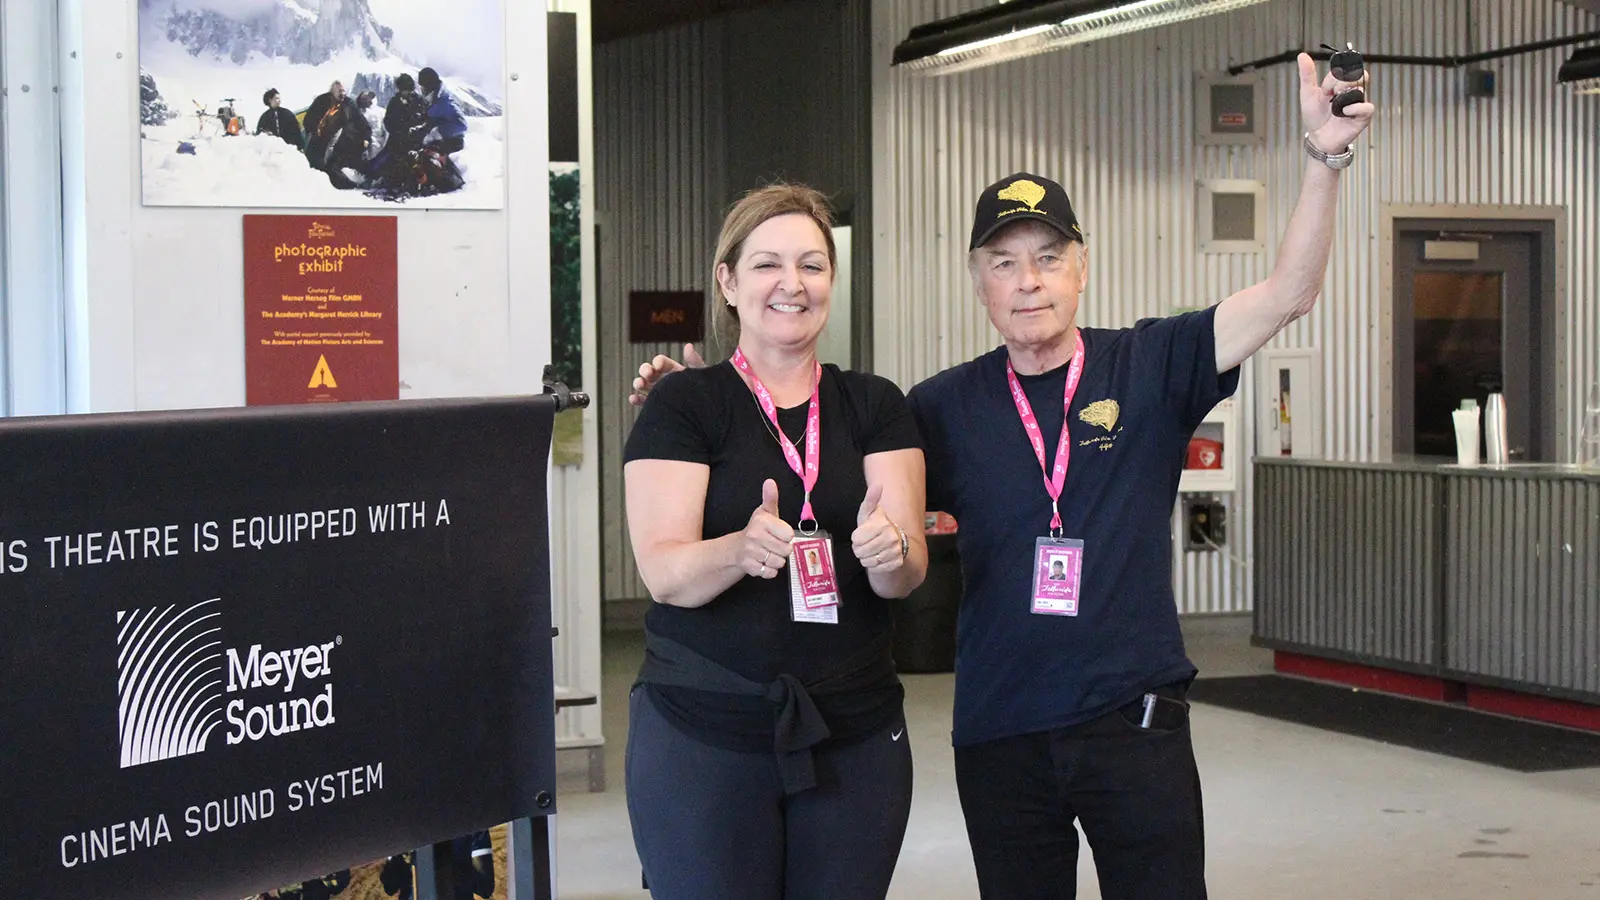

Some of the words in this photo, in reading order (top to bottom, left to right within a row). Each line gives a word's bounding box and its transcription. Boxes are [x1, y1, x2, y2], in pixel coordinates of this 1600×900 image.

[274, 311, 308, 319] Academy's
[309, 311, 336, 319] Margaret
[360, 311, 382, 319] Library
[305, 294, 327, 302] Herzog
[651, 309, 684, 324] MEN
[44, 525, 179, 568] THEATRE
[193, 521, 219, 552] IS
[232, 507, 357, 549] EQUIPPED
[368, 500, 426, 533] WITH
[435, 498, 451, 526] A
[226, 683, 336, 745] Sound
[60, 813, 172, 868] CINEMA
[184, 788, 275, 837] SOUND
[287, 761, 384, 812] SYSTEM
